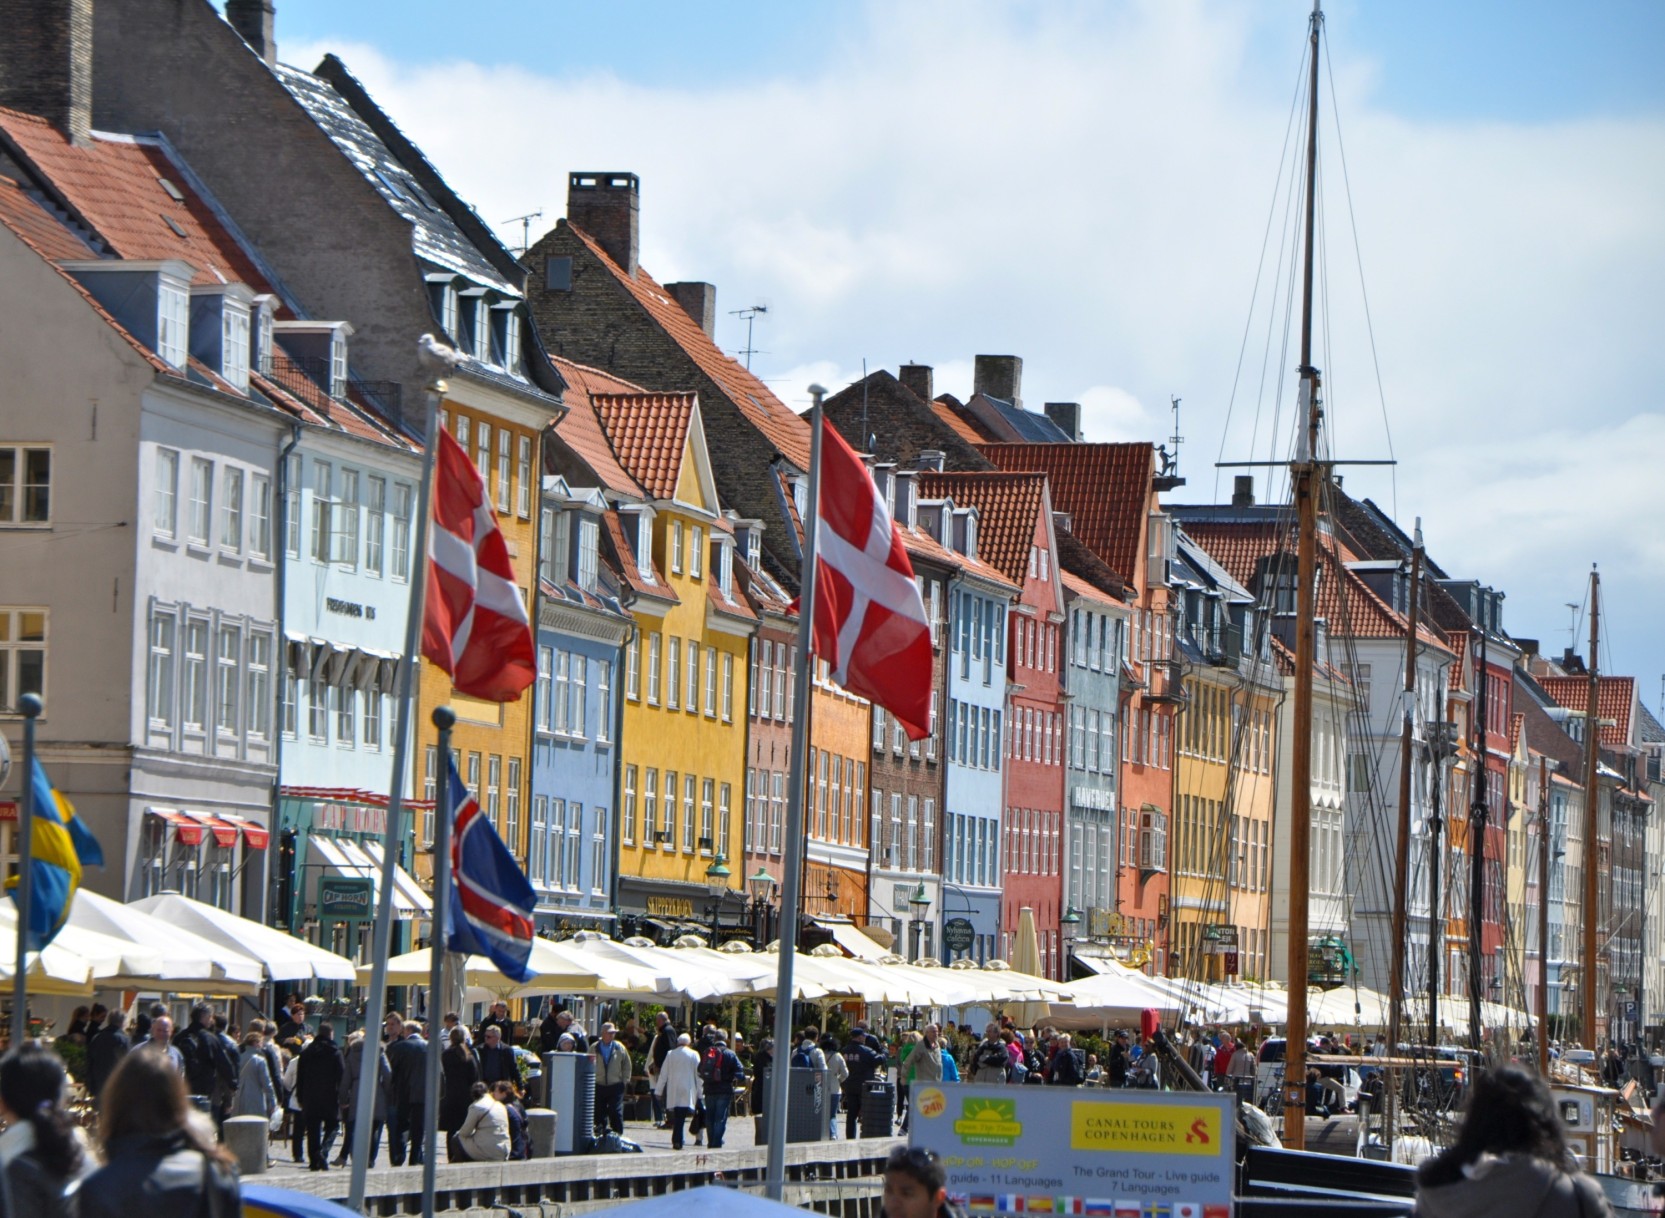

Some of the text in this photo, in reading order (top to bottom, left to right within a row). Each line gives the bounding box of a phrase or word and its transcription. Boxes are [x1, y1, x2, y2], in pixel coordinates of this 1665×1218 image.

[1626, 1002, 1635, 1013] P
[923, 1100, 943, 1115] 24h
[1086, 1118, 1175, 1131] CANAL TOURS
[1085, 1129, 1176, 1143] COPENHAGEN
[950, 1173, 979, 1185] guide
[991, 1175, 1000, 1185] 11
[1005, 1174, 1063, 1188] Languages
[1073, 1166, 1093, 1177] The
[1096, 1168, 1129, 1179] Grand
[1132, 1169, 1156, 1180] Tour
[1165, 1171, 1187, 1181] Live
[1190, 1172, 1220, 1184] guide
[1112, 1181, 1180, 1196] 7 Languages
